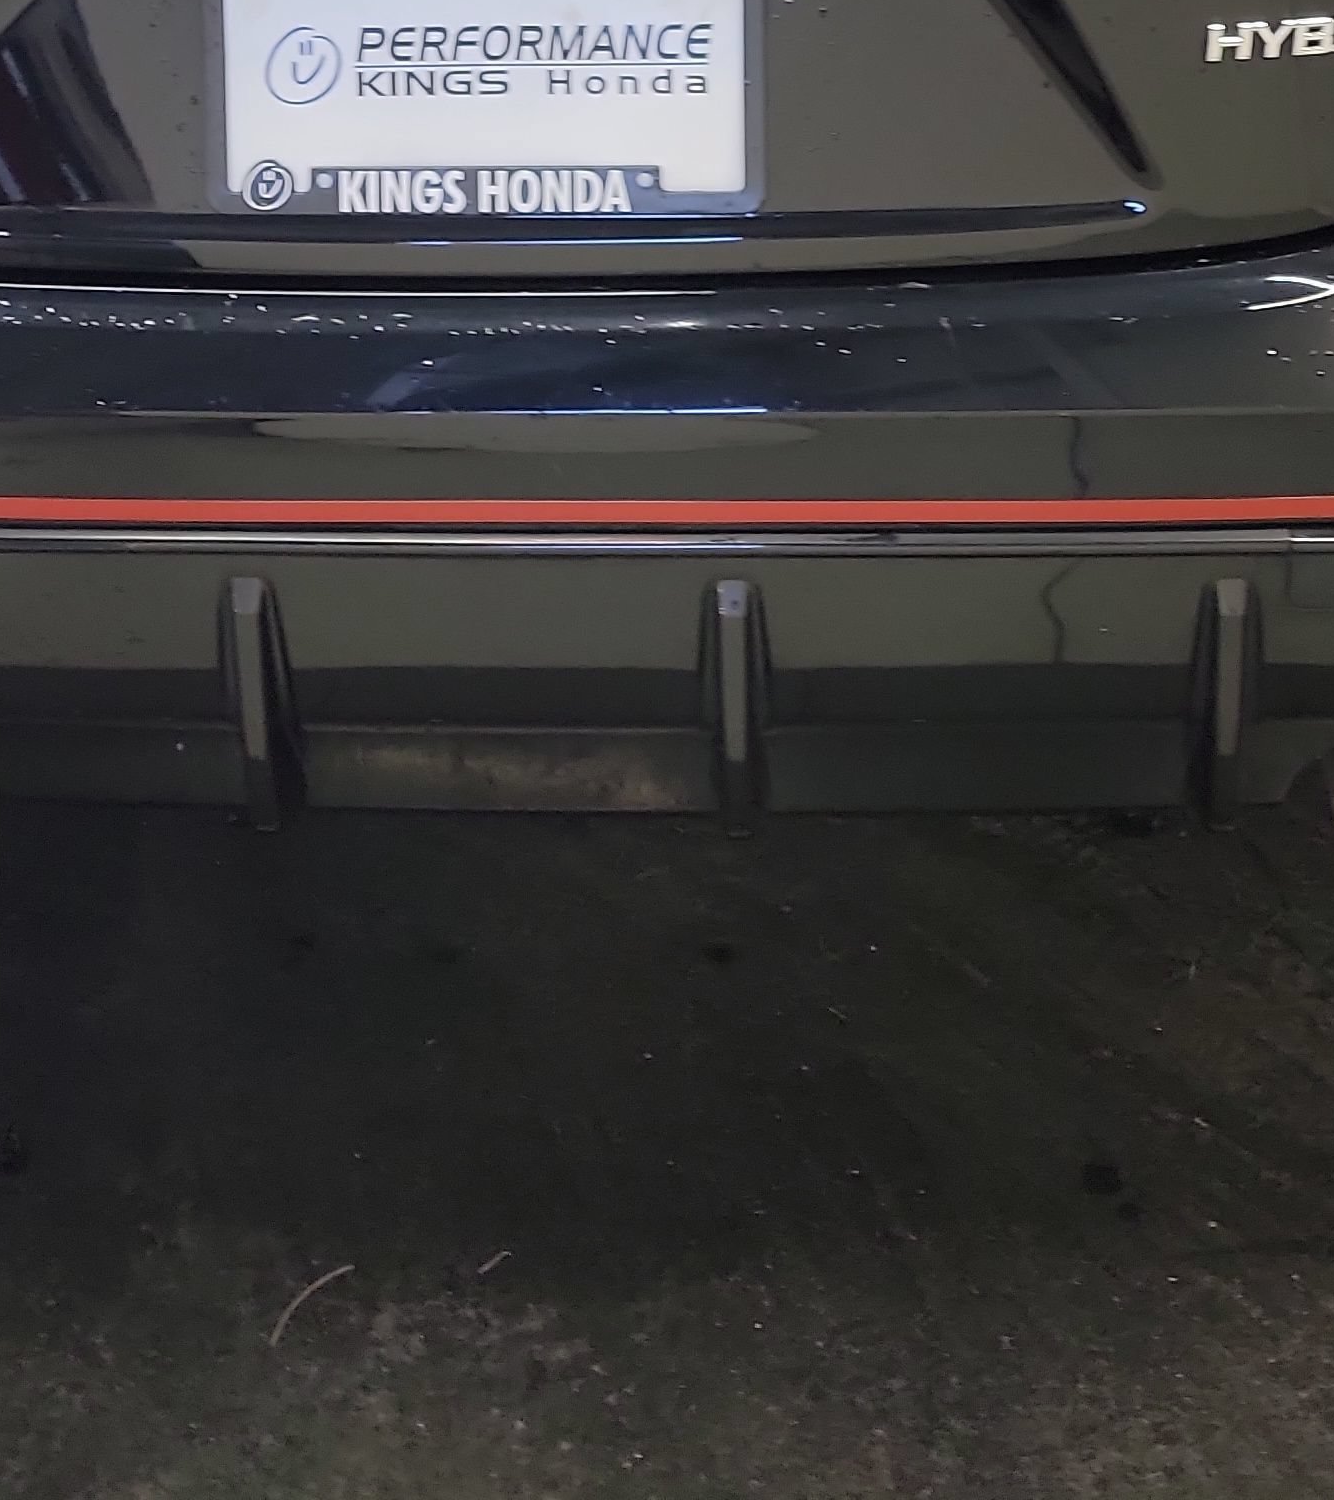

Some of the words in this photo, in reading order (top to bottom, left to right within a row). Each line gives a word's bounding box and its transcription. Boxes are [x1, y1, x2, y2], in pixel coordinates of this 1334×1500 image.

[356, 23, 714, 63] PERFORMANCE
[356, 70, 509, 98] KINGS
[547, 69, 708, 96] Honda
[337, 169, 467, 214] KINGS
[475, 169, 632, 214] HONDA
